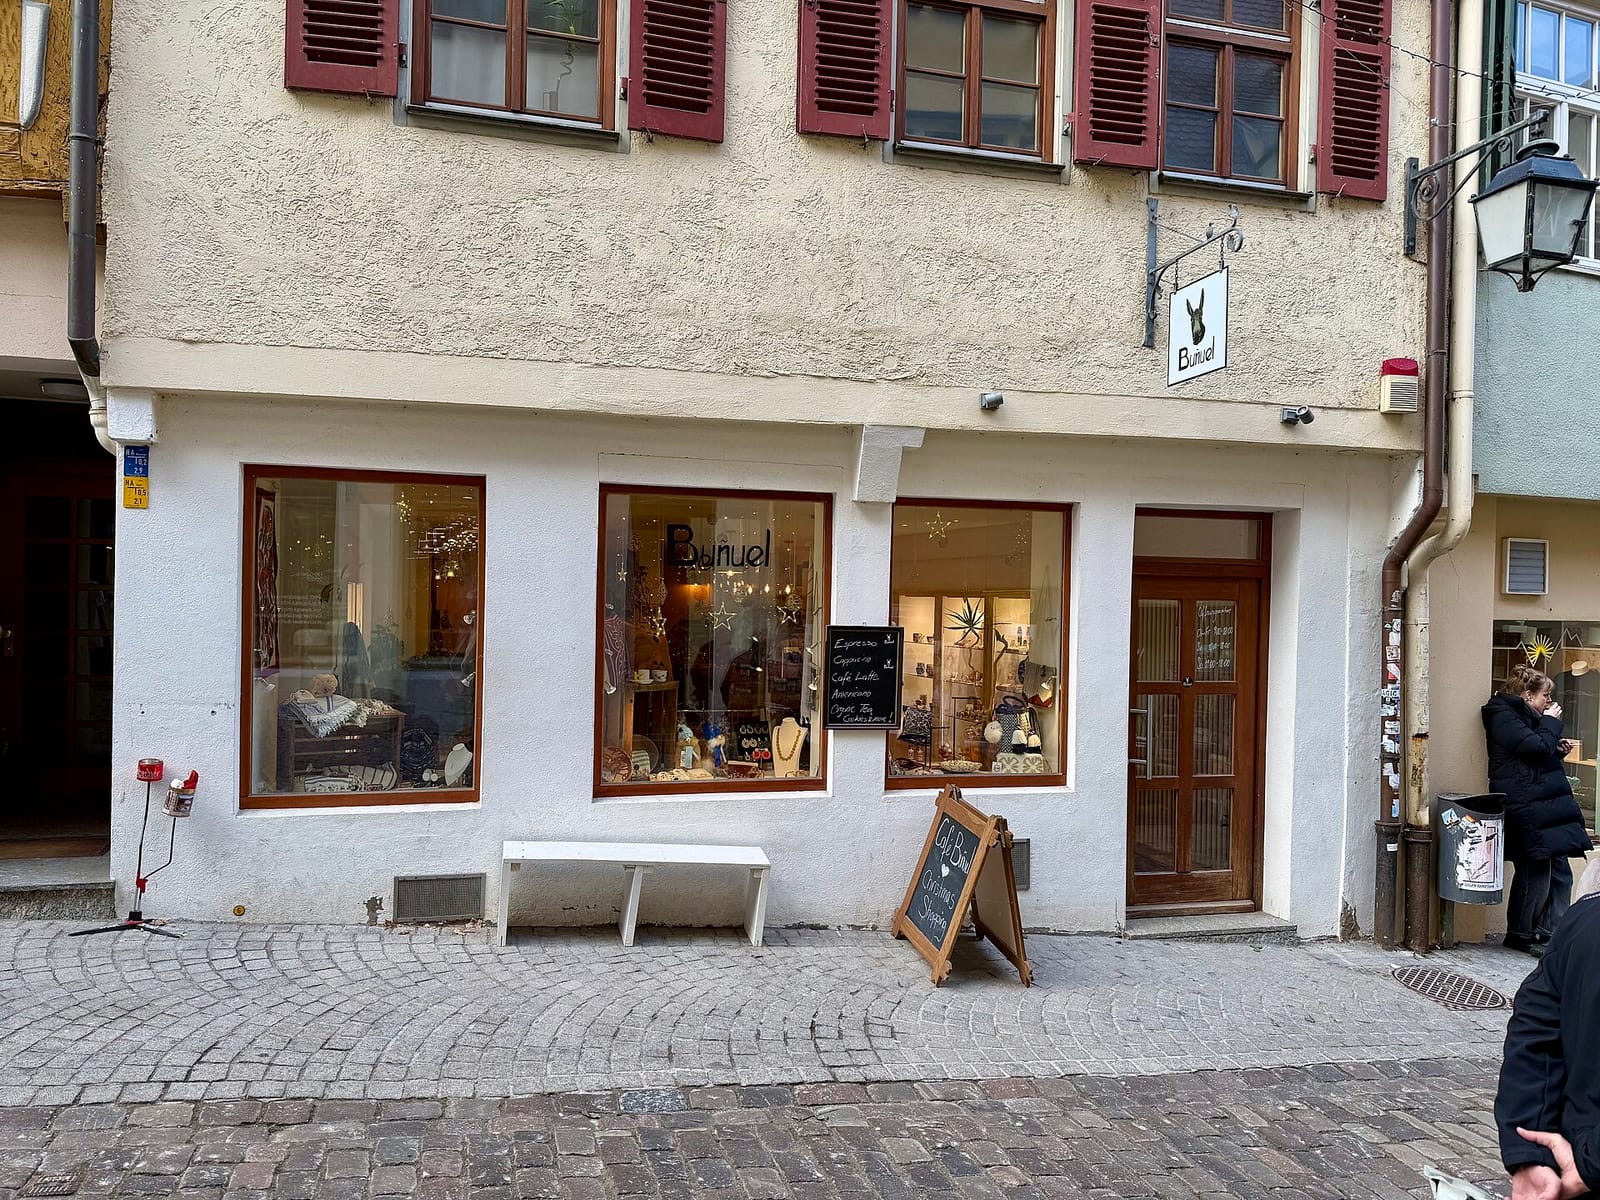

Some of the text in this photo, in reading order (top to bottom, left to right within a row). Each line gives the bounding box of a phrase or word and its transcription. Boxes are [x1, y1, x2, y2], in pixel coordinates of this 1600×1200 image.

[1178, 335, 1215, 372] Buñuel
[666, 523, 771, 567] Buñuel
[833, 638, 878, 651] Espresso
[831, 672, 852, 686] Café
[831, 689, 872, 700] Americano
[859, 703, 873, 716] Tea
[935, 817, 955, 862] Café
[921, 869, 956, 910] Christmas
[917, 894, 948, 942] Shopping
